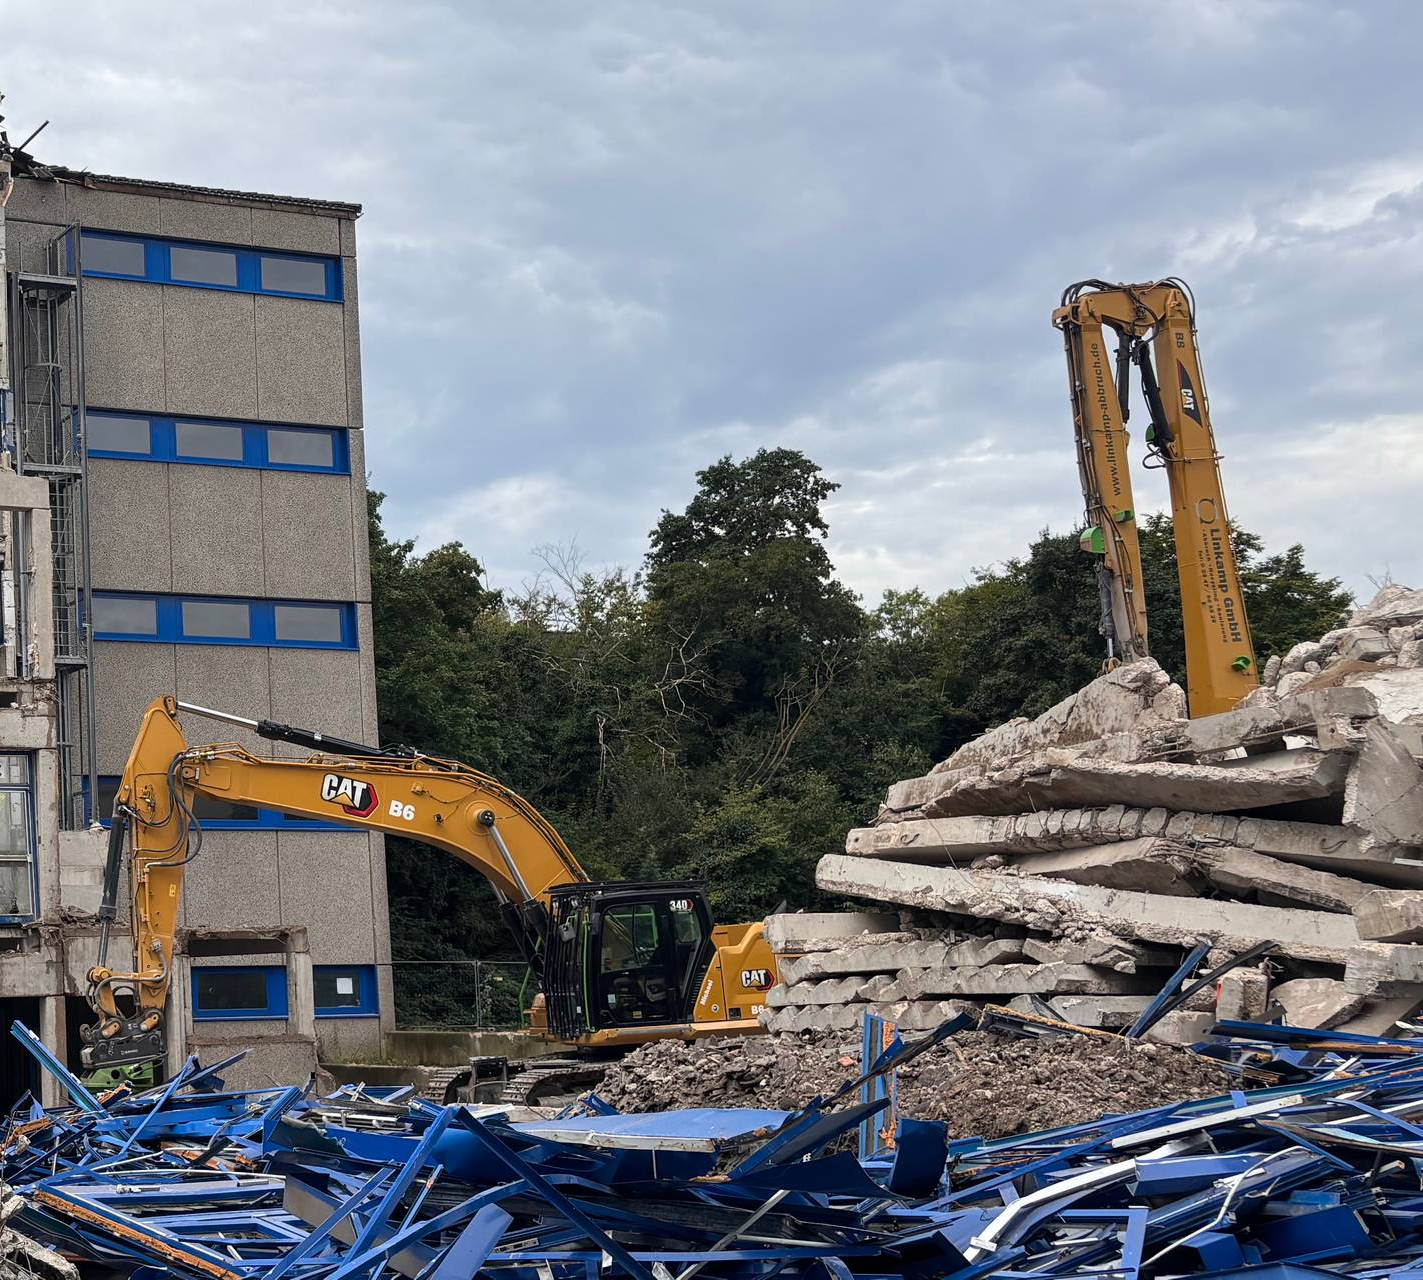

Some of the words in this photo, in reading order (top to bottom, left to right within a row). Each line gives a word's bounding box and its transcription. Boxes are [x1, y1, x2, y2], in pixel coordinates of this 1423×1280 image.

[1181, 388, 1195, 411] CAT
[1091, 343, 1121, 496] www.linkamp-abbruch.de
[1210, 528, 1229, 593] Linkamp
[1224, 597, 1242, 642] GmbH
[322, 773, 368, 809] CAT
[388, 799, 416, 820] B6
[669, 900, 688, 911] 340
[741, 968, 767, 988] CAT
[699, 979, 713, 1005] Michael
[751, 1004, 765, 1015] B6
